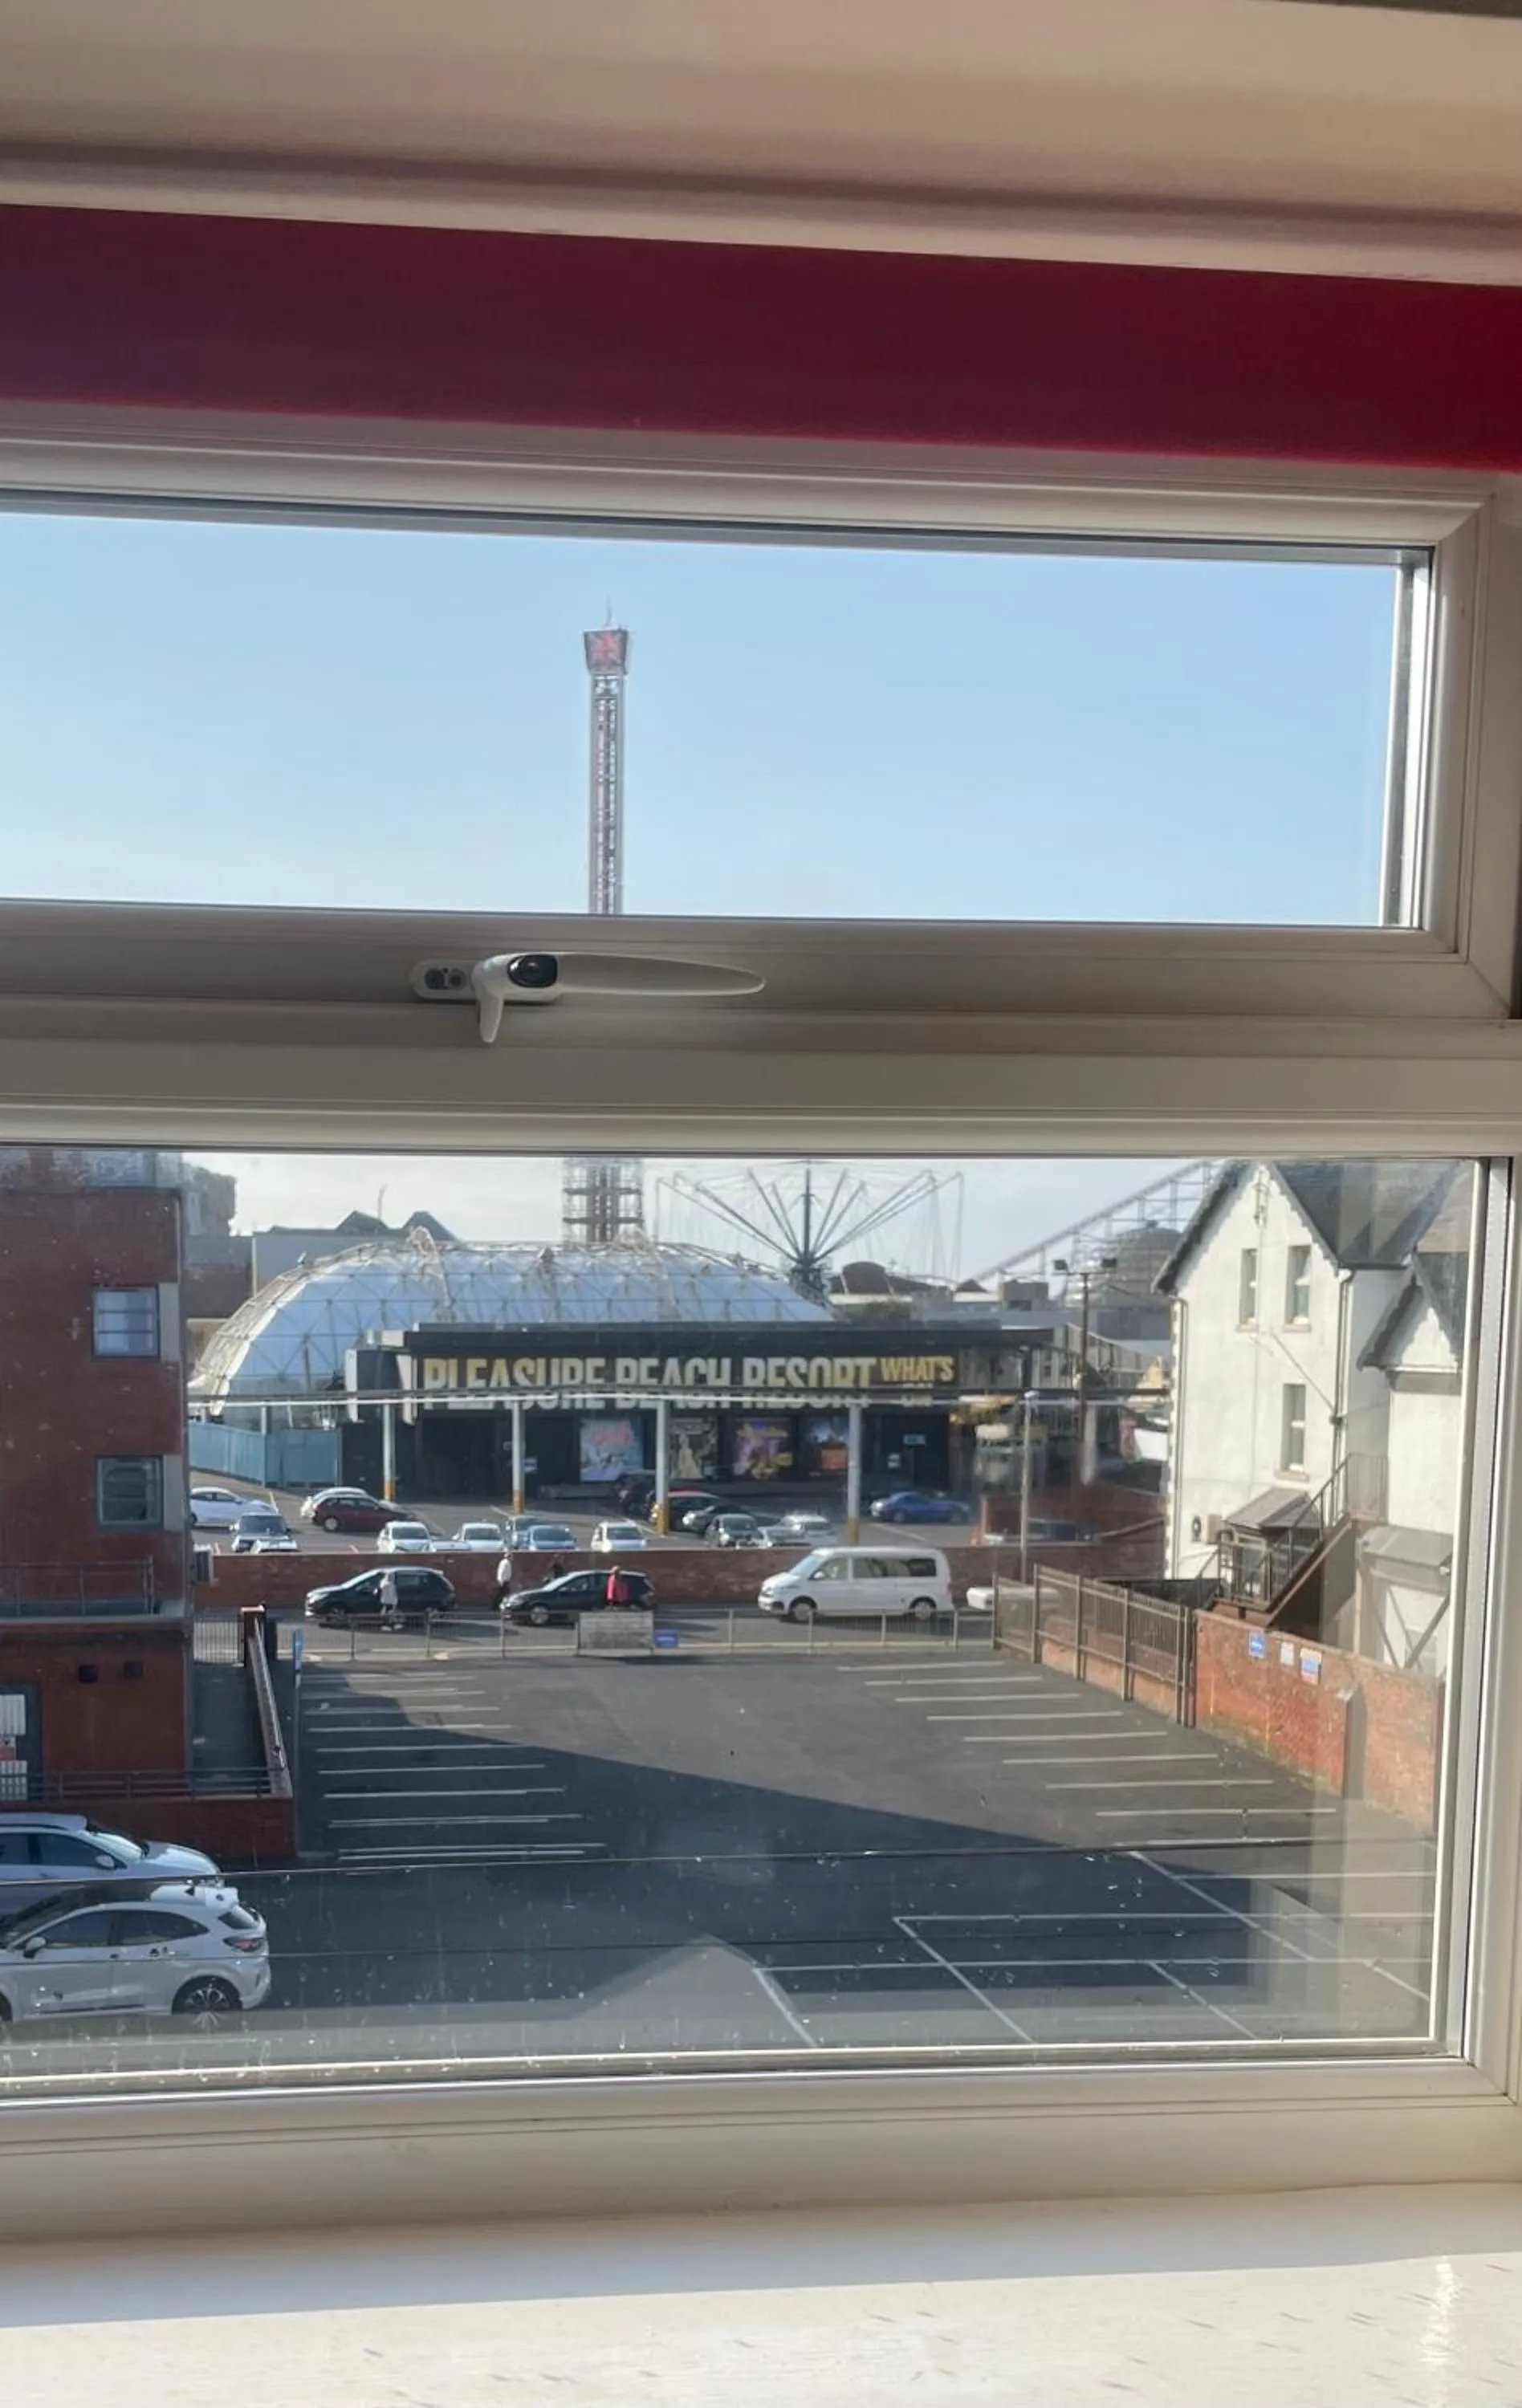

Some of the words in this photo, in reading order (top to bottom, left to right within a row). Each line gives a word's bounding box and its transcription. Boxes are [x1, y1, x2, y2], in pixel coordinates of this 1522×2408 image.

[422, 1357, 607, 1410] PLEASURE
[615, 1357, 732, 1409] BEACH
[742, 1357, 877, 1409] RESORT
